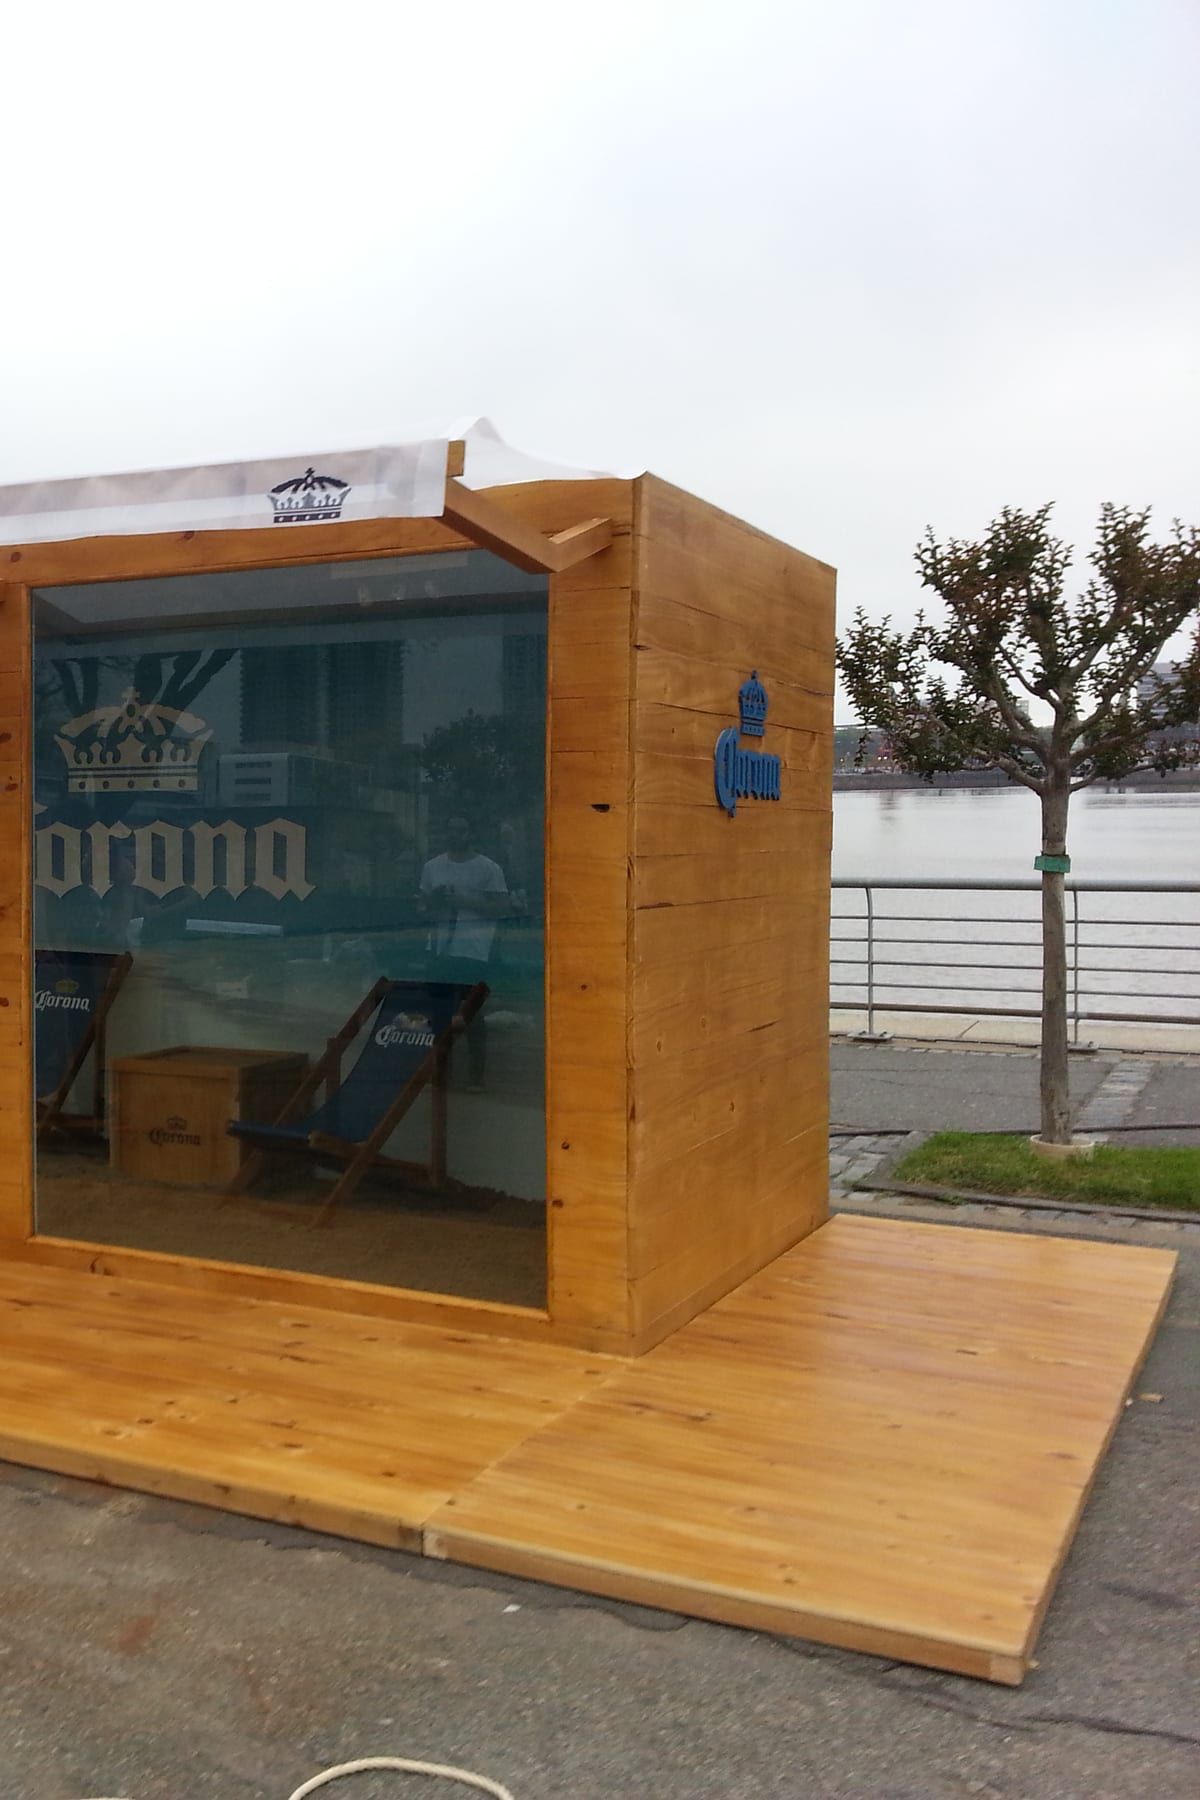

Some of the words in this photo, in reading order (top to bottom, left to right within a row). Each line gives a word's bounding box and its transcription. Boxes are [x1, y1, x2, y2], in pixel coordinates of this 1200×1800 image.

[34, 990, 90, 1011] Corona
[375, 1024, 435, 1048] Corona
[149, 1128, 201, 1147] Corona
